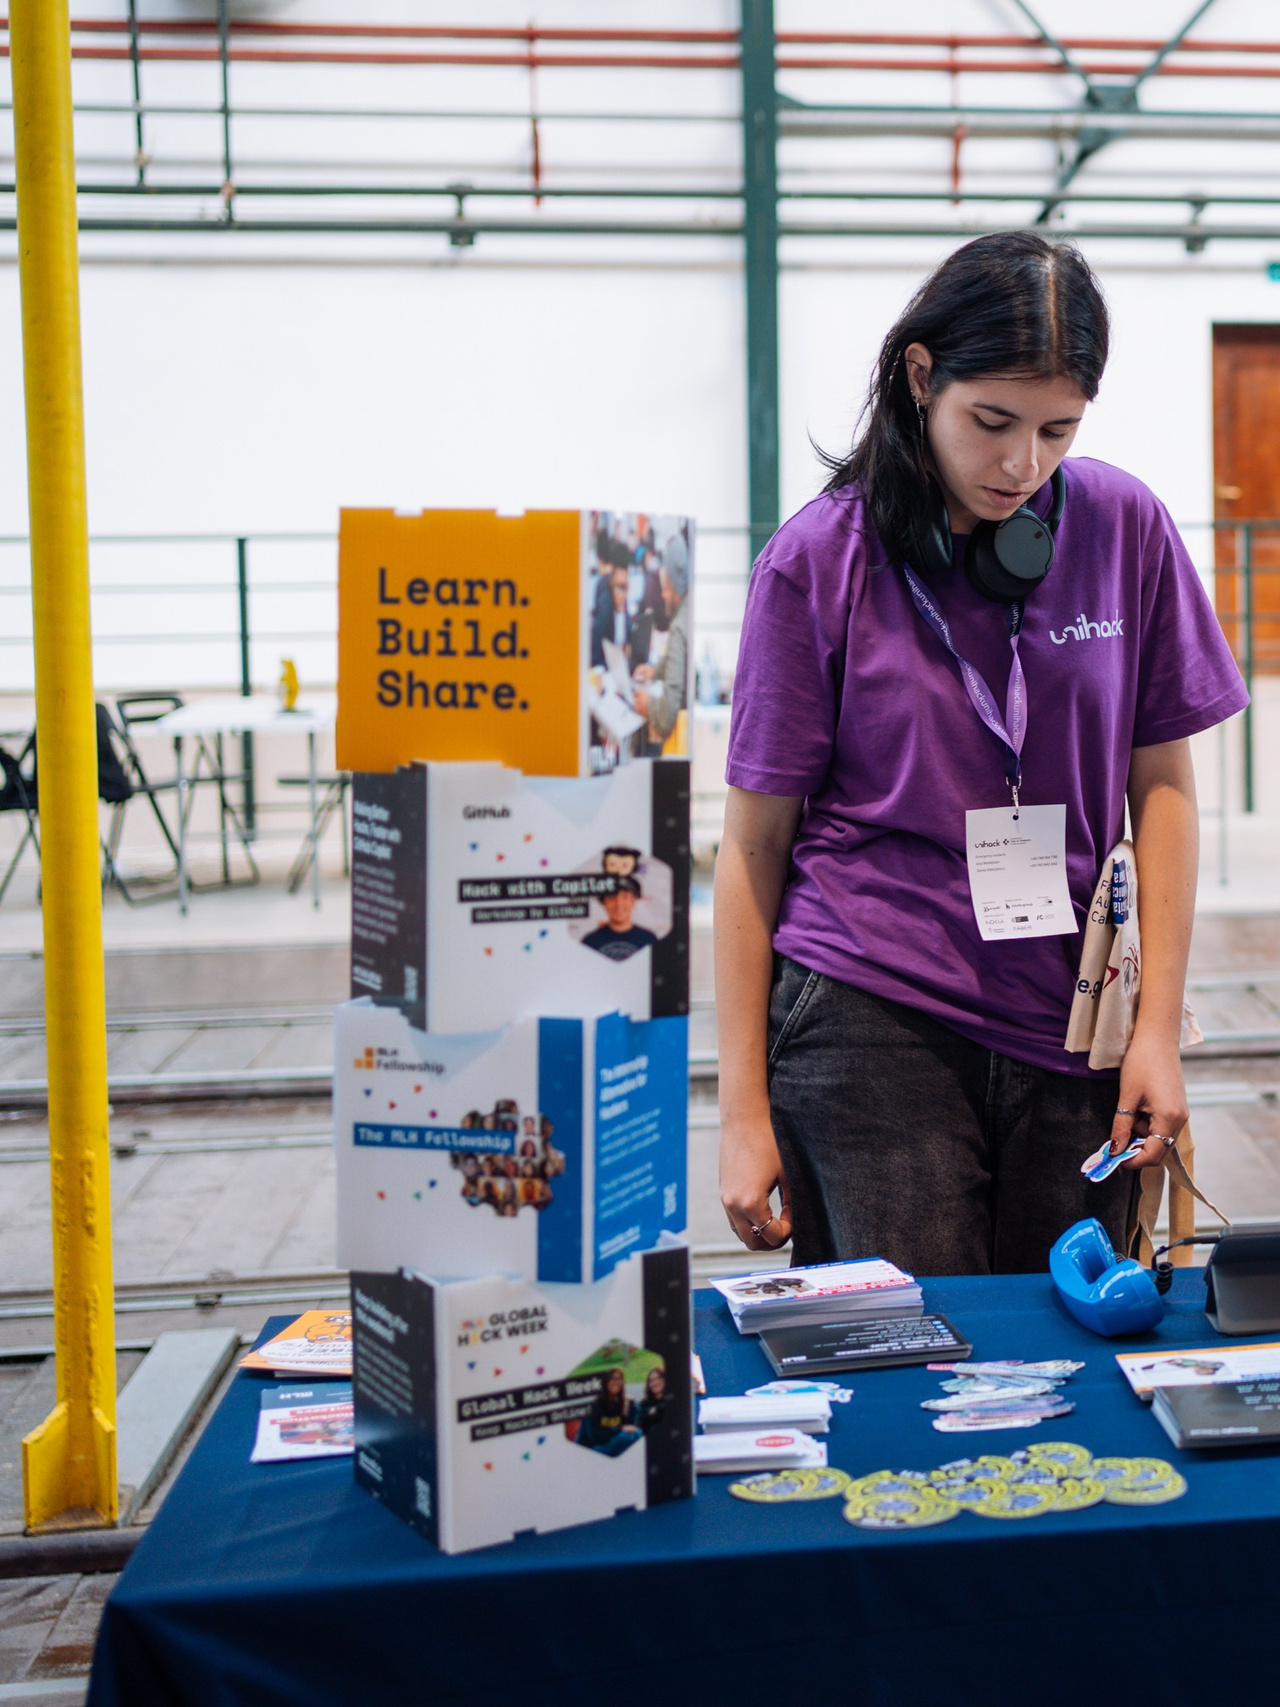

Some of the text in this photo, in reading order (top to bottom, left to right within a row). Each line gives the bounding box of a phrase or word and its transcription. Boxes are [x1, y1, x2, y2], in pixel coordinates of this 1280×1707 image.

[377, 566, 530, 607] Learn.
[1049, 608, 1124, 645] unihack
[376, 618, 530, 659] Build.
[376, 669, 530, 711] Share.
[463, 804, 511, 821] GitHub
[974, 838, 1001, 849] unihack
[461, 877, 617, 899] Hack with Copilot
[1100, 879, 1112, 893] Fa
[1095, 895, 1109, 909] Au
[1091, 910, 1107, 925] Ca
[376, 1058, 445, 1075] Fellowship
[358, 1127, 512, 1151] The MLH Fellowship
[489, 1305, 548, 1328] GLOBAL
[506, 1319, 548, 1339] WEEK
[461, 1377, 602, 1419] Global Hack Week
